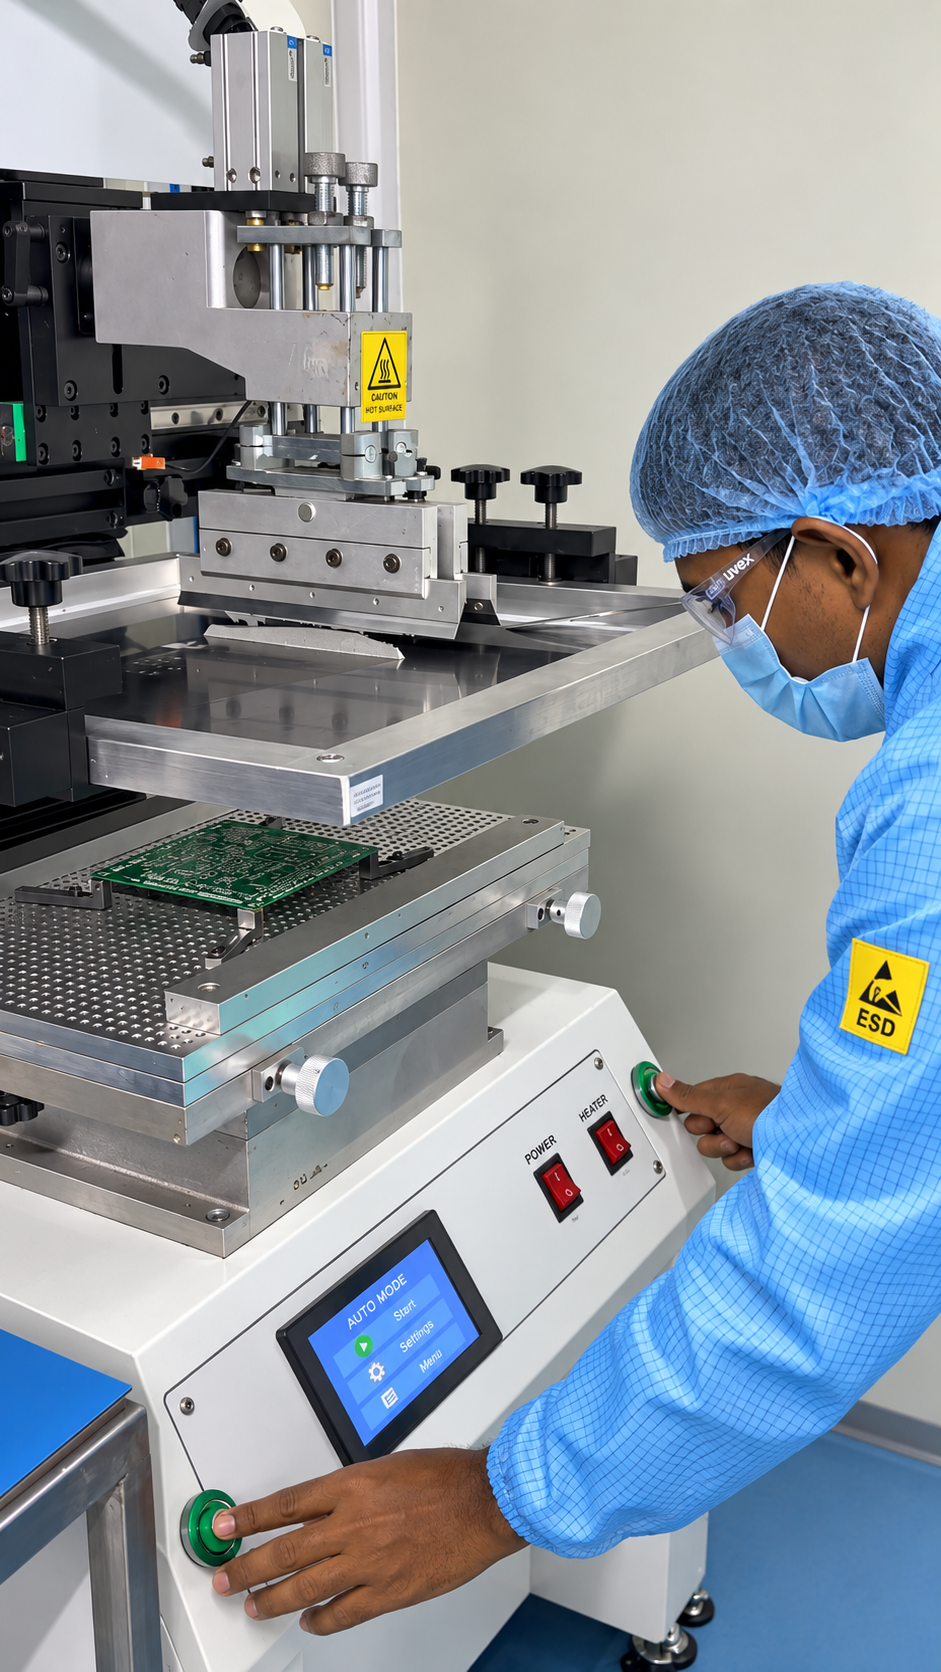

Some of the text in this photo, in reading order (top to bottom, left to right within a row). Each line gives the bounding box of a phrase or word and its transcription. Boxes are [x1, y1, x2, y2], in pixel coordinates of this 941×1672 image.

[365, 406, 378, 414] HOT
[723, 553, 755, 581] uvex
[856, 1007, 895, 1037] ESD
[578, 1094, 609, 1122] HEATER
[524, 1134, 557, 1165] POWER
[347, 1273, 408, 1330] AUTO MODE
[393, 1299, 417, 1322] Start
[400, 1320, 434, 1353] Settings
